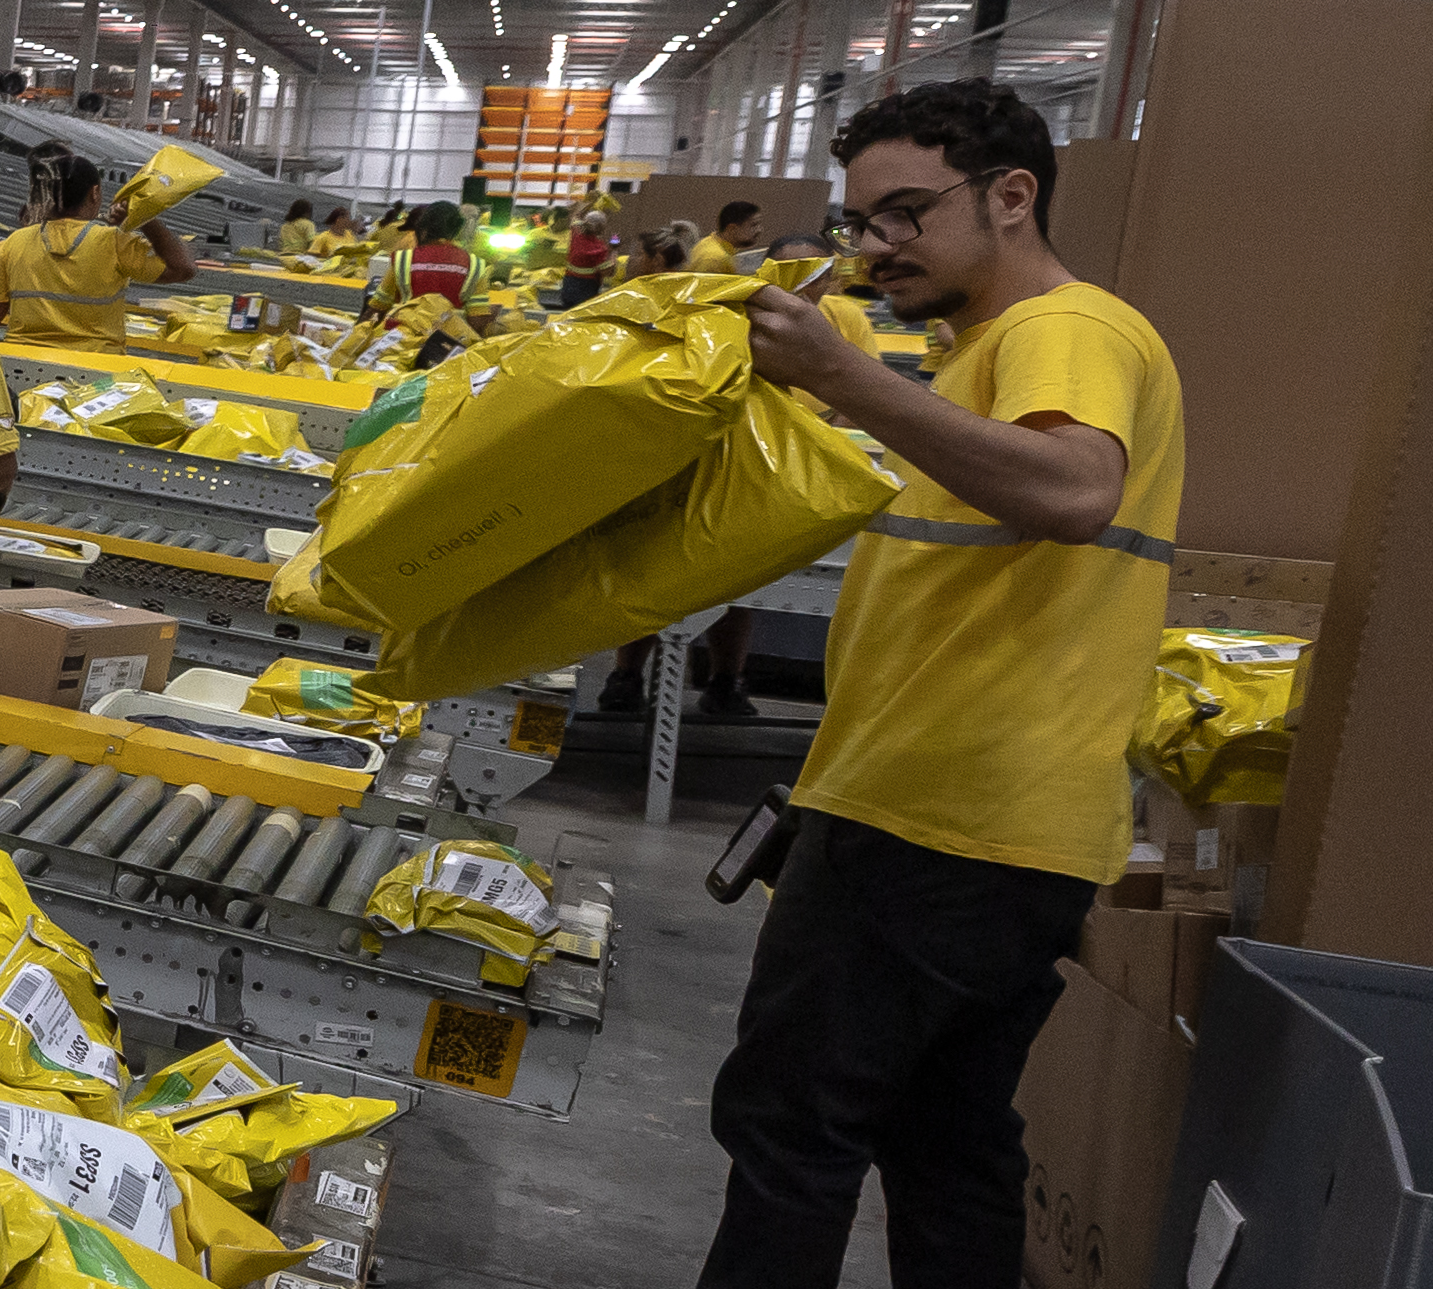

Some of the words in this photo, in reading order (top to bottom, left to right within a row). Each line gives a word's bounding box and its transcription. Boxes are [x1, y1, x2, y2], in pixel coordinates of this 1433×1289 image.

[482, 877, 508, 905] MG5
[444, 1070, 476, 1087] 094
[68, 1142, 102, 1195] SSP31
